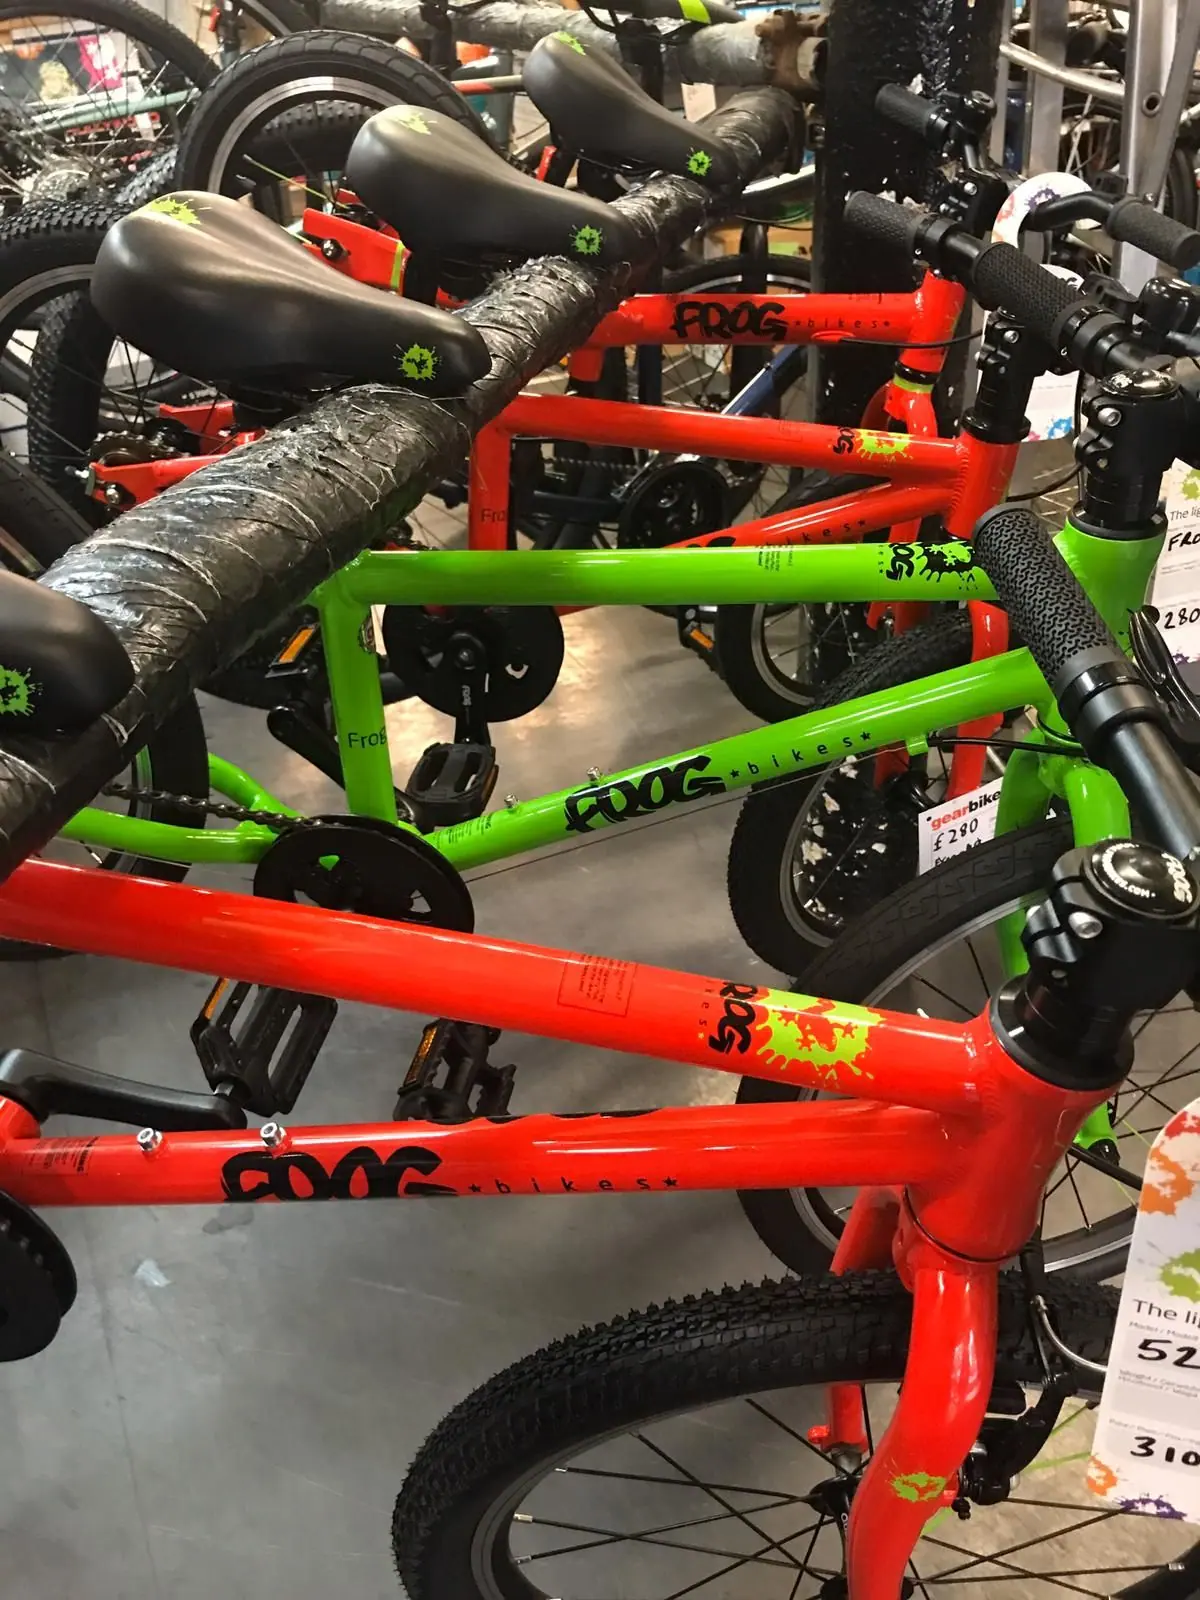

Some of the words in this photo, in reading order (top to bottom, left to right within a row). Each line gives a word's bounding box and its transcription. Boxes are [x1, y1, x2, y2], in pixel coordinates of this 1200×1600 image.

[670, 301, 788, 341] FROG
[808, 316, 878, 329] bikes
[481, 508, 506, 523] Fro
[1169, 509, 1189, 521] The
[1164, 608, 1200, 629] 280
[564, 755, 727, 832] FROG
[749, 735, 854, 775] bikes
[931, 790, 1001, 831] gearbike
[708, 981, 758, 1054] ROG
[221, 1146, 458, 1200] FROG
[495, 1176, 651, 1194] bikes
[1133, 1298, 1178, 1321] The
[1184, 1310, 1200, 1329] li
[1137, 1338, 1200, 1369] 52
[1130, 1436, 1200, 1466] 310
